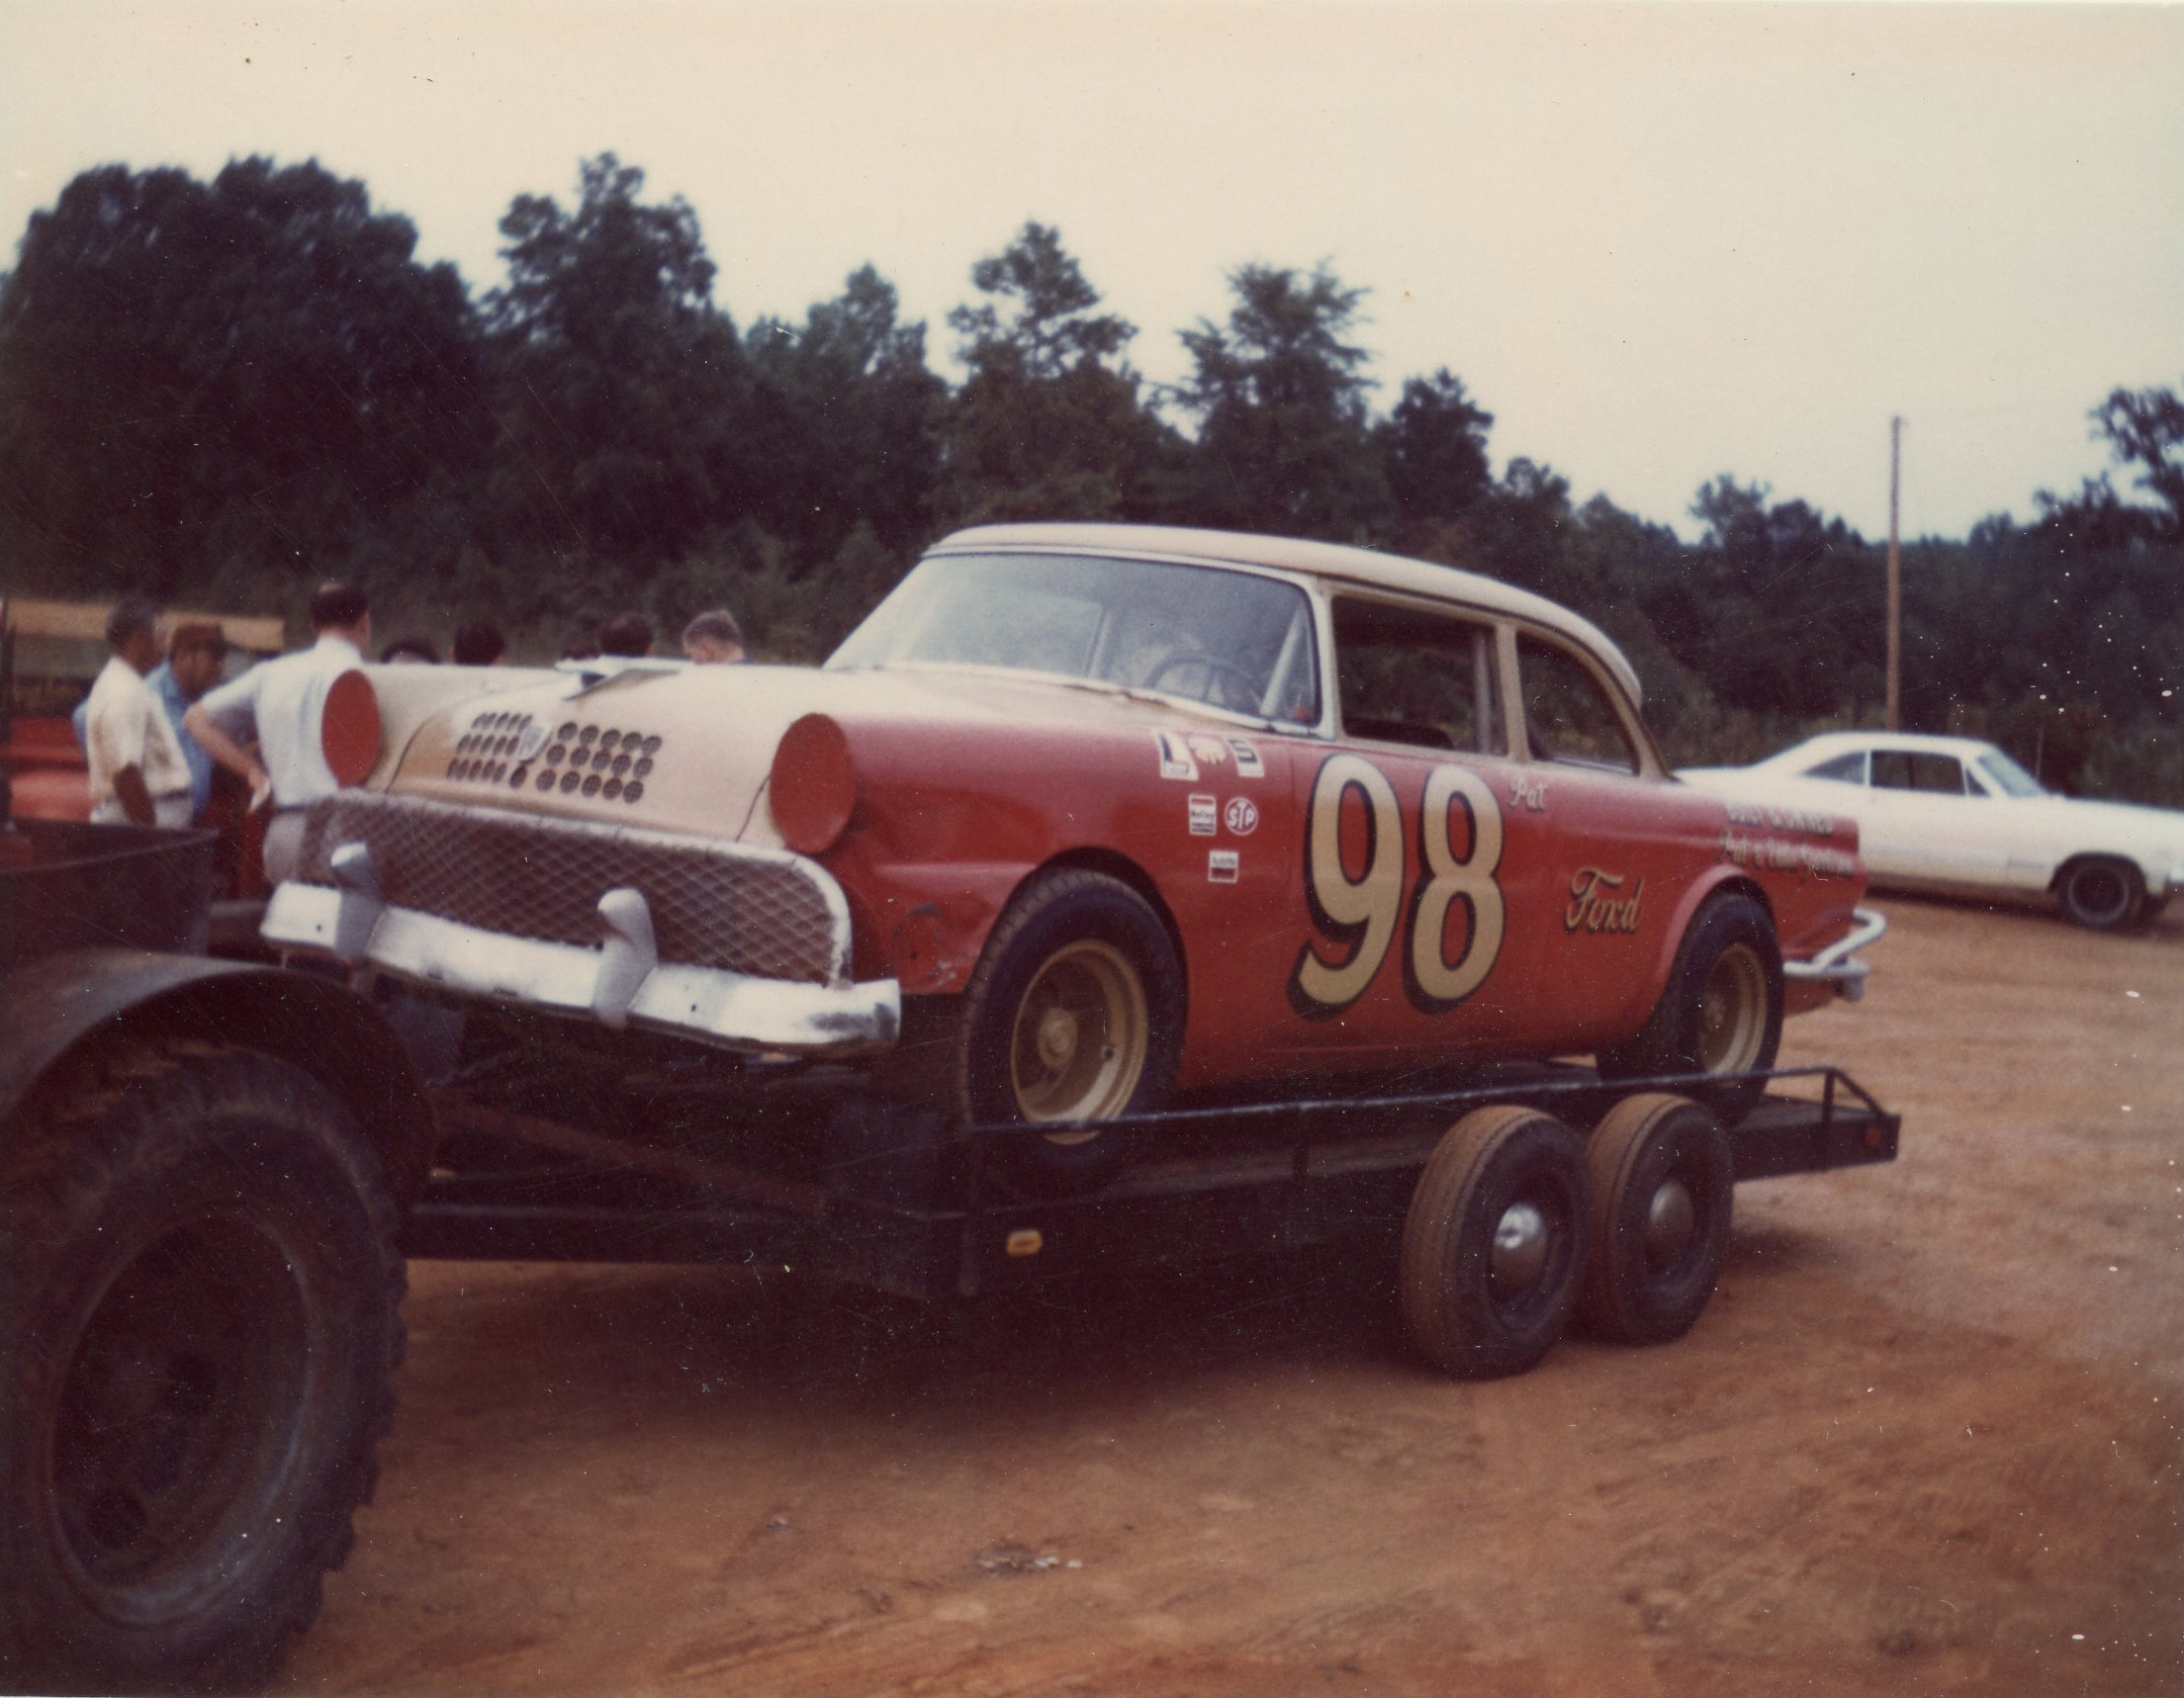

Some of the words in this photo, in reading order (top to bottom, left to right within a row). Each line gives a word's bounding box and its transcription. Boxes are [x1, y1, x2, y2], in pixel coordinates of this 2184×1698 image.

[1228, 801, 1256, 829] STP
[1289, 754, 1504, 1021] 98
[1565, 866, 1645, 934] Ford
